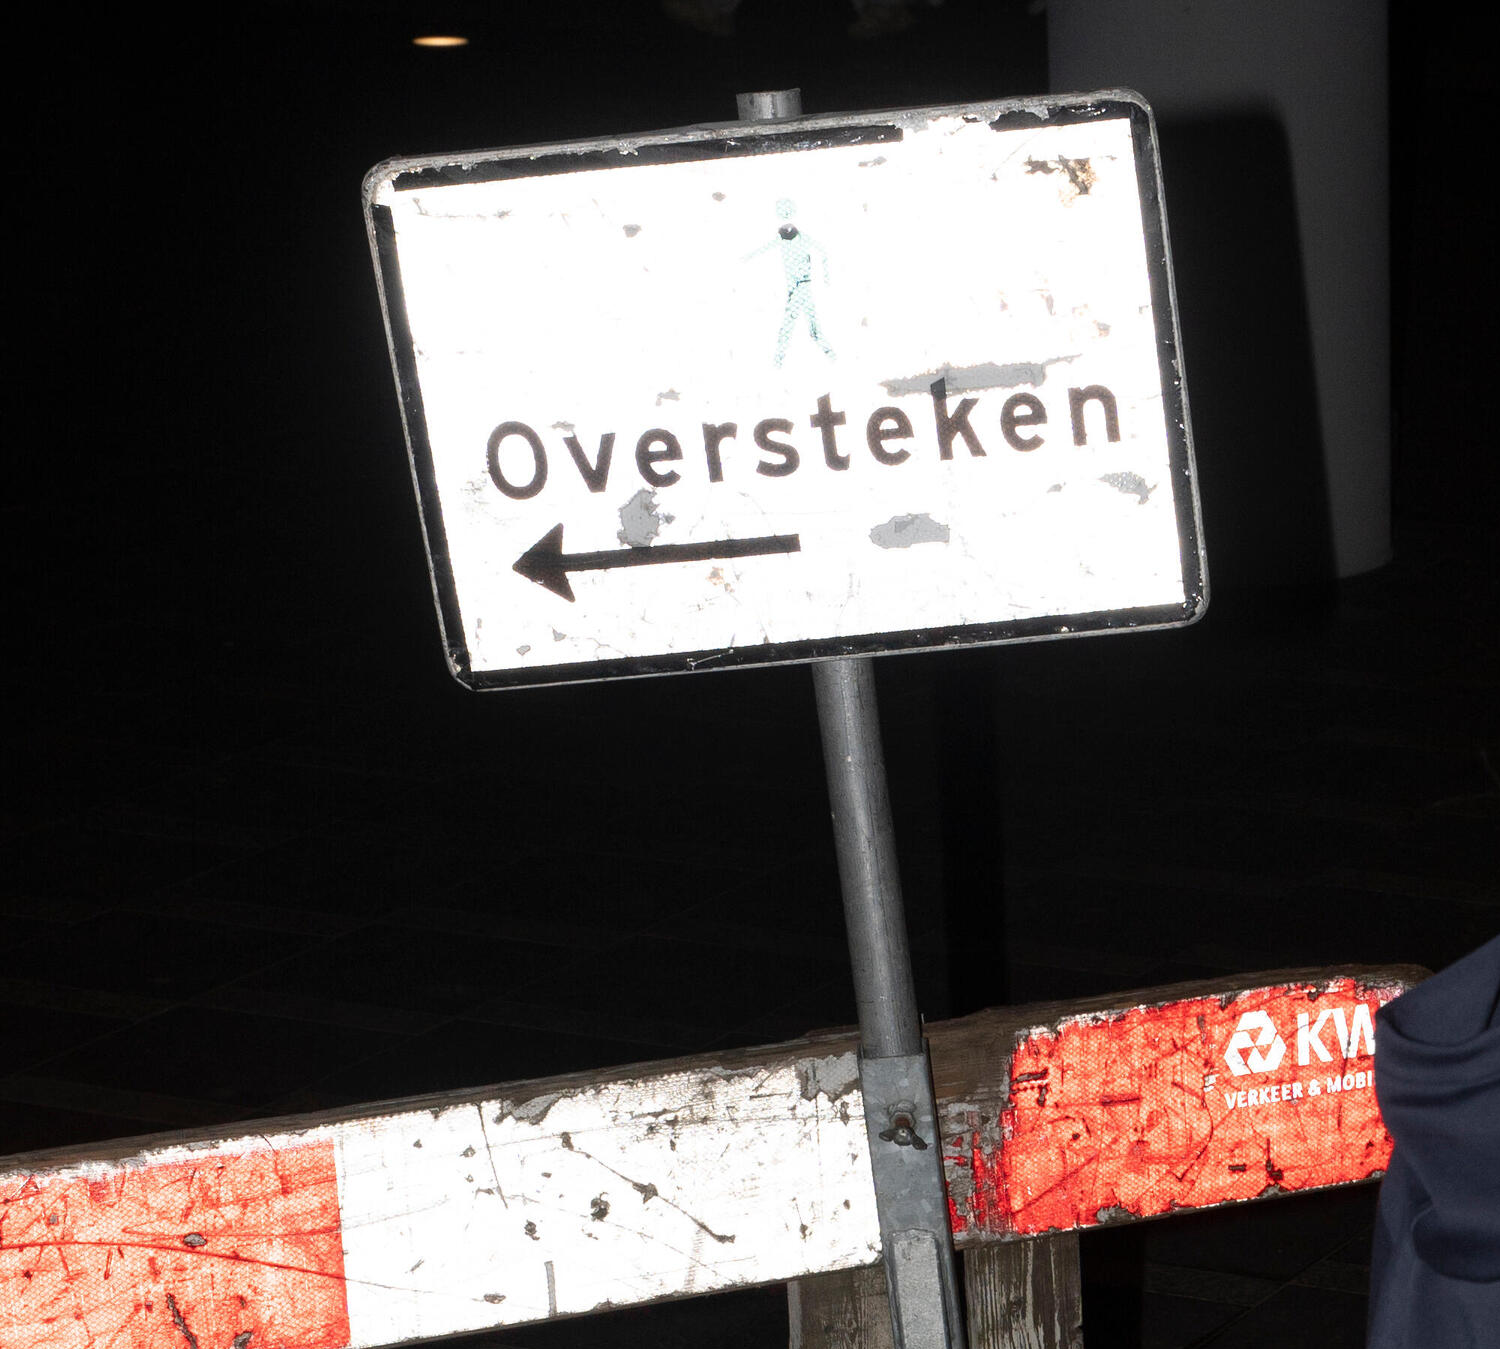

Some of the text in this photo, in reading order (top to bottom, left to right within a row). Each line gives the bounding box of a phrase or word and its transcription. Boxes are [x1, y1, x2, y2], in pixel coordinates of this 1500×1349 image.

[486, 376, 1121, 500] Oversteken
[1224, 1082, 1304, 1110] VERKEER
[1308, 1078, 1322, 1097] &
